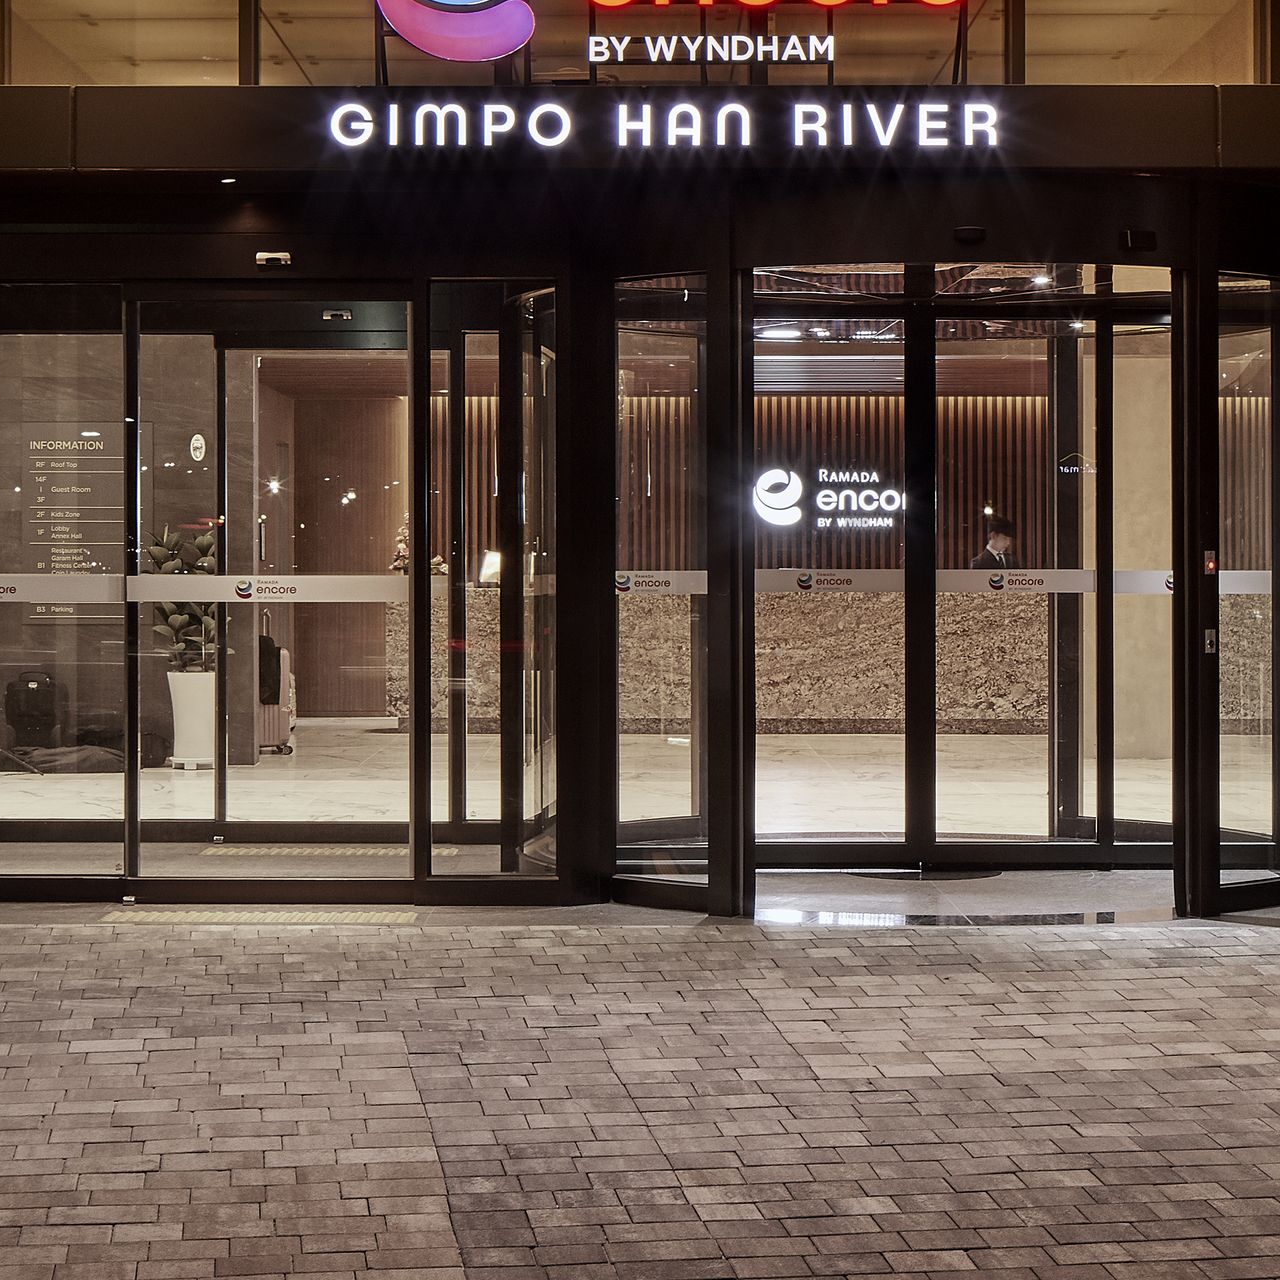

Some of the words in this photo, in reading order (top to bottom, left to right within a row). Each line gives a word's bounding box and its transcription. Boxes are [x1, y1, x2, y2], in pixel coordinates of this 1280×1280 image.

[589, 36, 631, 61] BY
[644, 35, 835, 61] WYNDHAM
[330, 103, 572, 147] GIMPO
[618, 103, 751, 146] HAN
[793, 103, 999, 146] RIVER
[29, 441, 104, 450] INFORMATION
[819, 469, 879, 483] RAMADA
[818, 517, 832, 527] BY
[837, 517, 893, 527] WYNDHAM
[815, 578, 853, 586] encore
[1007, 578, 1044, 586] encore
[256, 586, 297, 594] encore
[51, 606, 74, 614] Parking
